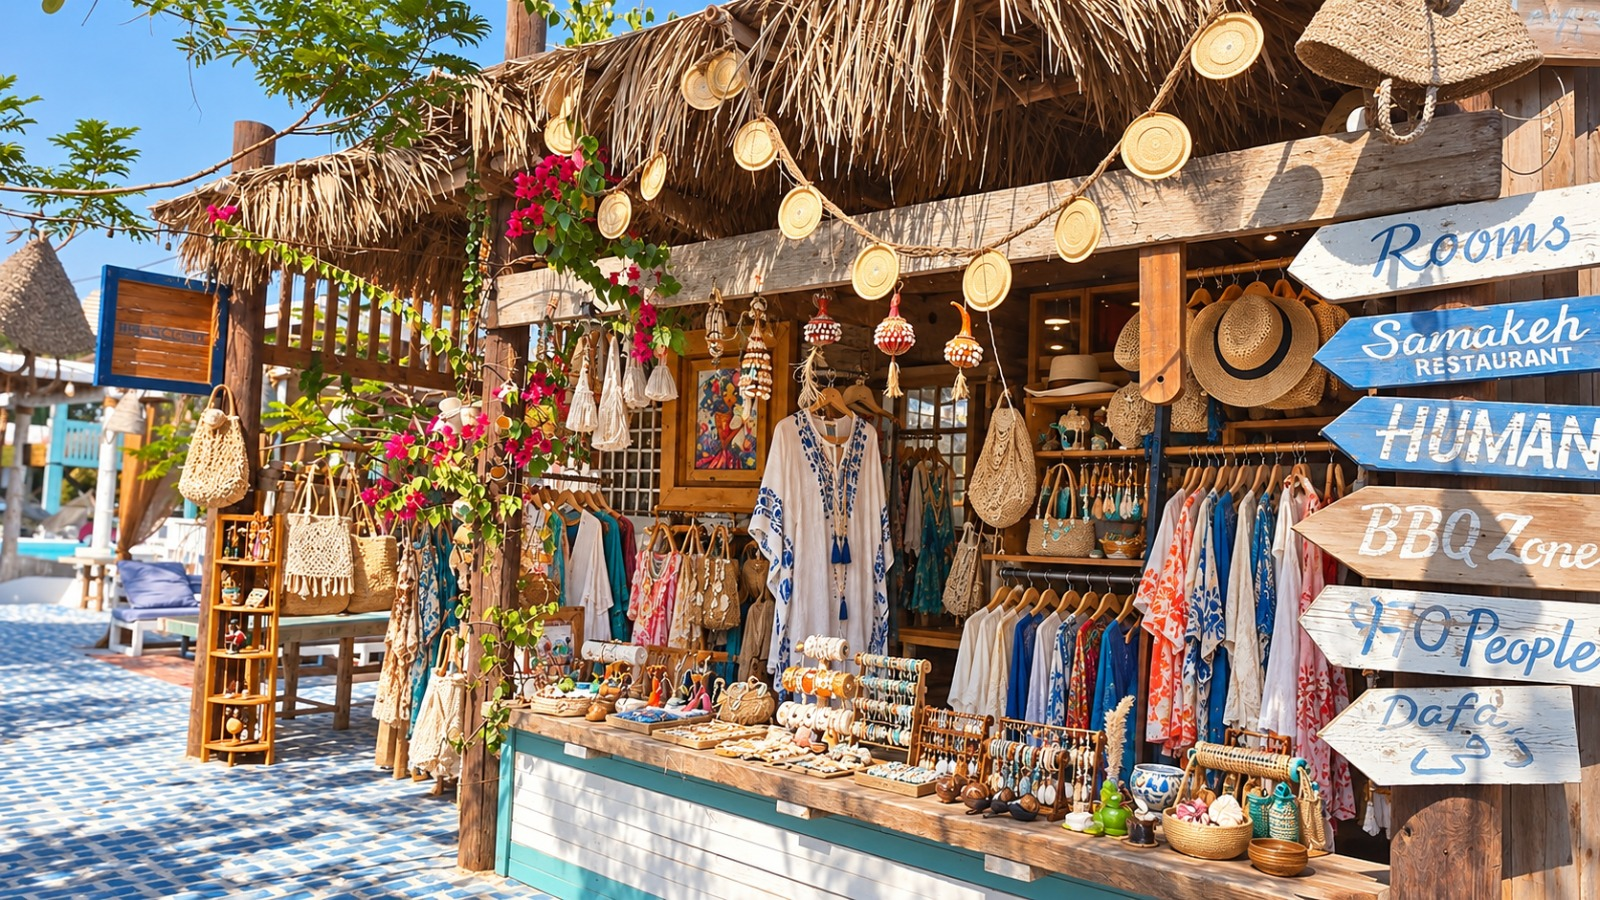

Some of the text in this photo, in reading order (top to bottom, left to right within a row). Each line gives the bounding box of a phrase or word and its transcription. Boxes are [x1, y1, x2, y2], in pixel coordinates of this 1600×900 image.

[1370, 215, 1571, 278] Rooms
[1361, 303, 1590, 360] Samakeh
[1414, 347, 1572, 377] RESTAURANT
[1375, 403, 1600, 471] HUMAN
[1357, 502, 1600, 570] BBQ Zone
[1458, 608, 1600, 677] People
